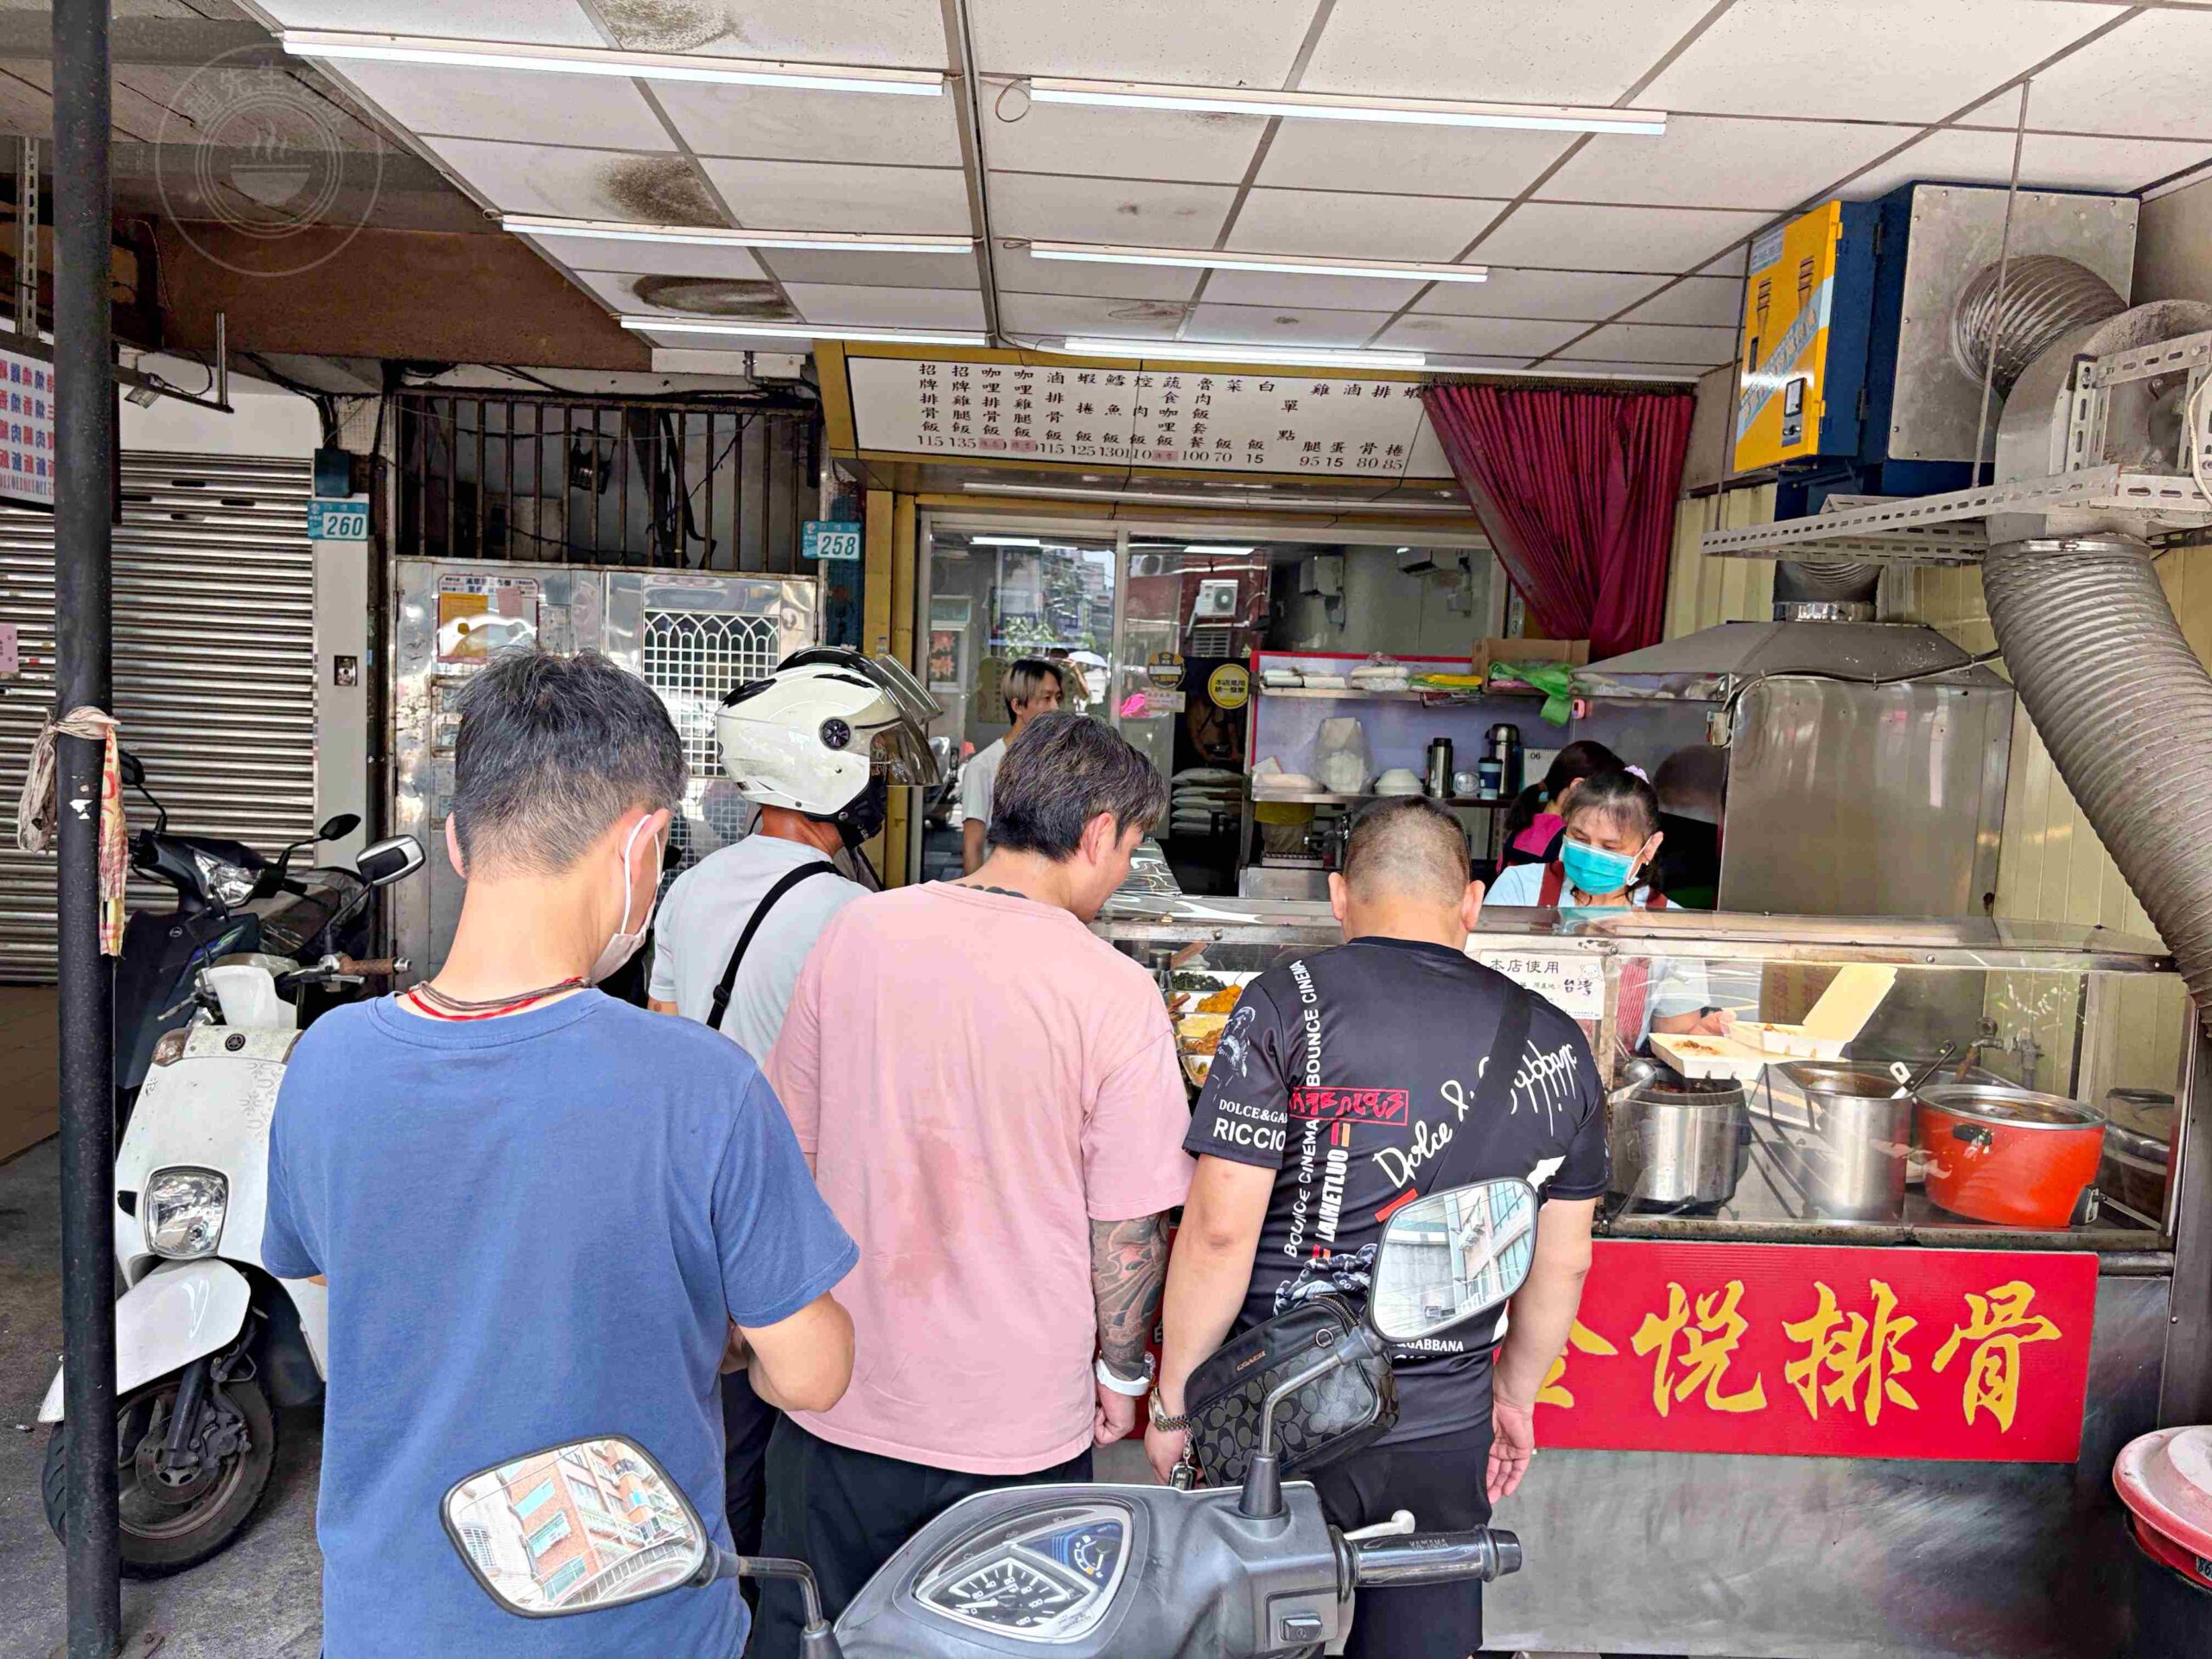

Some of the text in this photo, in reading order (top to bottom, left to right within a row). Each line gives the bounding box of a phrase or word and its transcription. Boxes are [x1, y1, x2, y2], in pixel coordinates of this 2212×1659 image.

[919, 363, 940, 432] 招牌排骨飯
[951, 365, 971, 434] 招牌雞腿飯
[982, 367, 1001, 435] 咖哩排骨飯
[1013, 369, 1034, 437] 咖哩雞腿飯
[1046, 372, 1065, 441] 滷排骨飯
[1276, 400, 1299, 441] 單點
[918, 435, 944, 447] 115
[950, 437, 976, 448] 135
[1039, 443, 1065, 454] 115
[1071, 445, 1096, 455] 125
[1099, 447, 1124, 457] 130
[1124, 448, 1152, 460] 110
[1182, 450, 1209, 461] 100
[1214, 452, 1232, 462] 70
[1246, 454, 1263, 463] 15
[1300, 455, 1320, 467] 95
[1326, 457, 1344, 467] 15
[1356, 458, 1378, 469] 80
[1382, 459, 1402, 470] 85
[327, 515, 364, 536] 260
[820, 536, 856, 556] 258
[1530, 752, 1541, 760] 06
[1491, 958, 1560, 975] 本店使用
[1289, 959, 1321, 1087] BOUNCE CINEMA
[1372, 1120, 1452, 1188] Dolce
[1284, 1119, 1320, 1258] BOUNCE CINEMA
[1409, 1538, 1449, 1550] YAMAHA
[985, 1580, 997, 1589] 40
[1020, 1585, 1033, 1594] 80
[1028, 1599, 1043, 1610] 100
